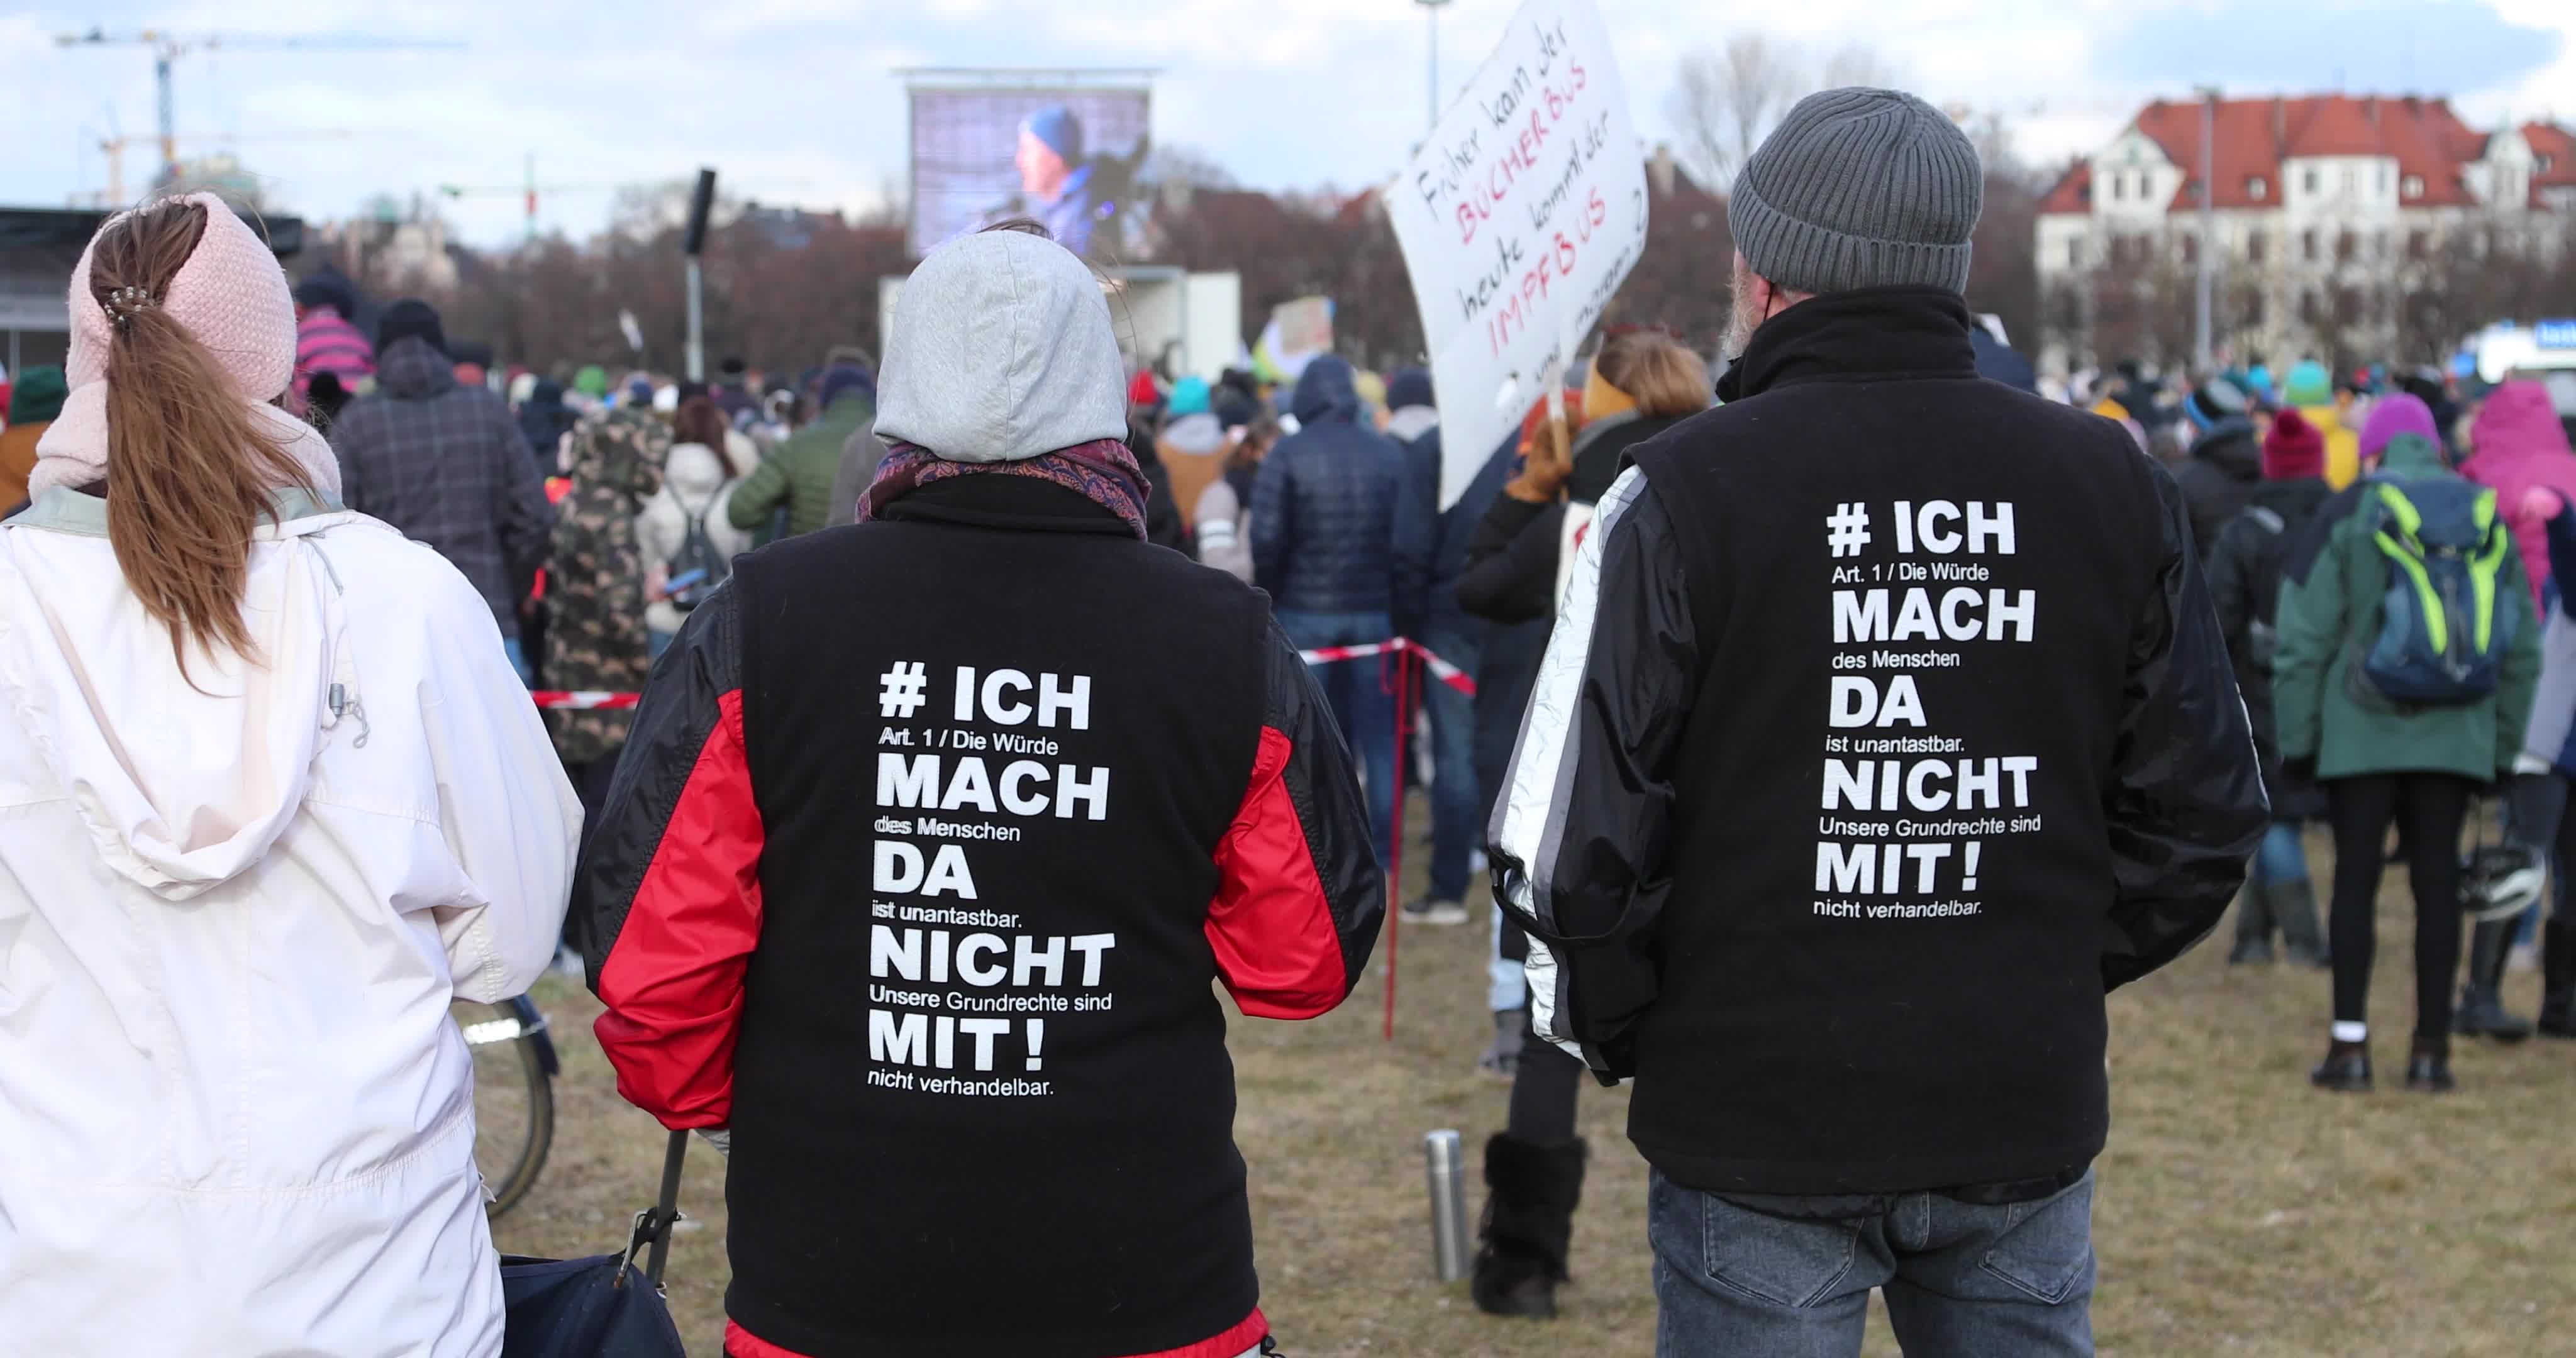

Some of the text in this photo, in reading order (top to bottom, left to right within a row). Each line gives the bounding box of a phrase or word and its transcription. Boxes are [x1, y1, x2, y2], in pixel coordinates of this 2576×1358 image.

[1479, 65, 1532, 131] kam
[1533, 16, 1567, 77] der
[1457, 108, 1609, 322] heute kommt der
[1826, 500, 2015, 557] # ICH
[1832, 563, 1989, 583] Art. 1 / Die Würde
[1833, 587, 2035, 643] MACH
[1832, 649, 1960, 669] des Menschen
[879, 661, 1091, 729] # ICH
[1829, 675, 1926, 727] DA
[879, 727, 1058, 755] Art. 1 / Die Würde
[1826, 734, 1965, 753] ist unantastbar.
[877, 753, 1109, 820] MACH
[1822, 756, 2037, 811] NICHT
[874, 815, 1020, 841] des Menschen
[1819, 815, 2041, 836] Unsere Grundrechte sind
[874, 840, 977, 899] DA
[872, 900, 1022, 927] ist unantastbar.
[1814, 899, 1982, 918] nicht verhandelbar.
[870, 925, 1115, 986] NICHT
[870, 984, 1111, 1011] Unsere Grundrechte sind
[868, 1069, 1053, 1096] nicht verhandelbar.
